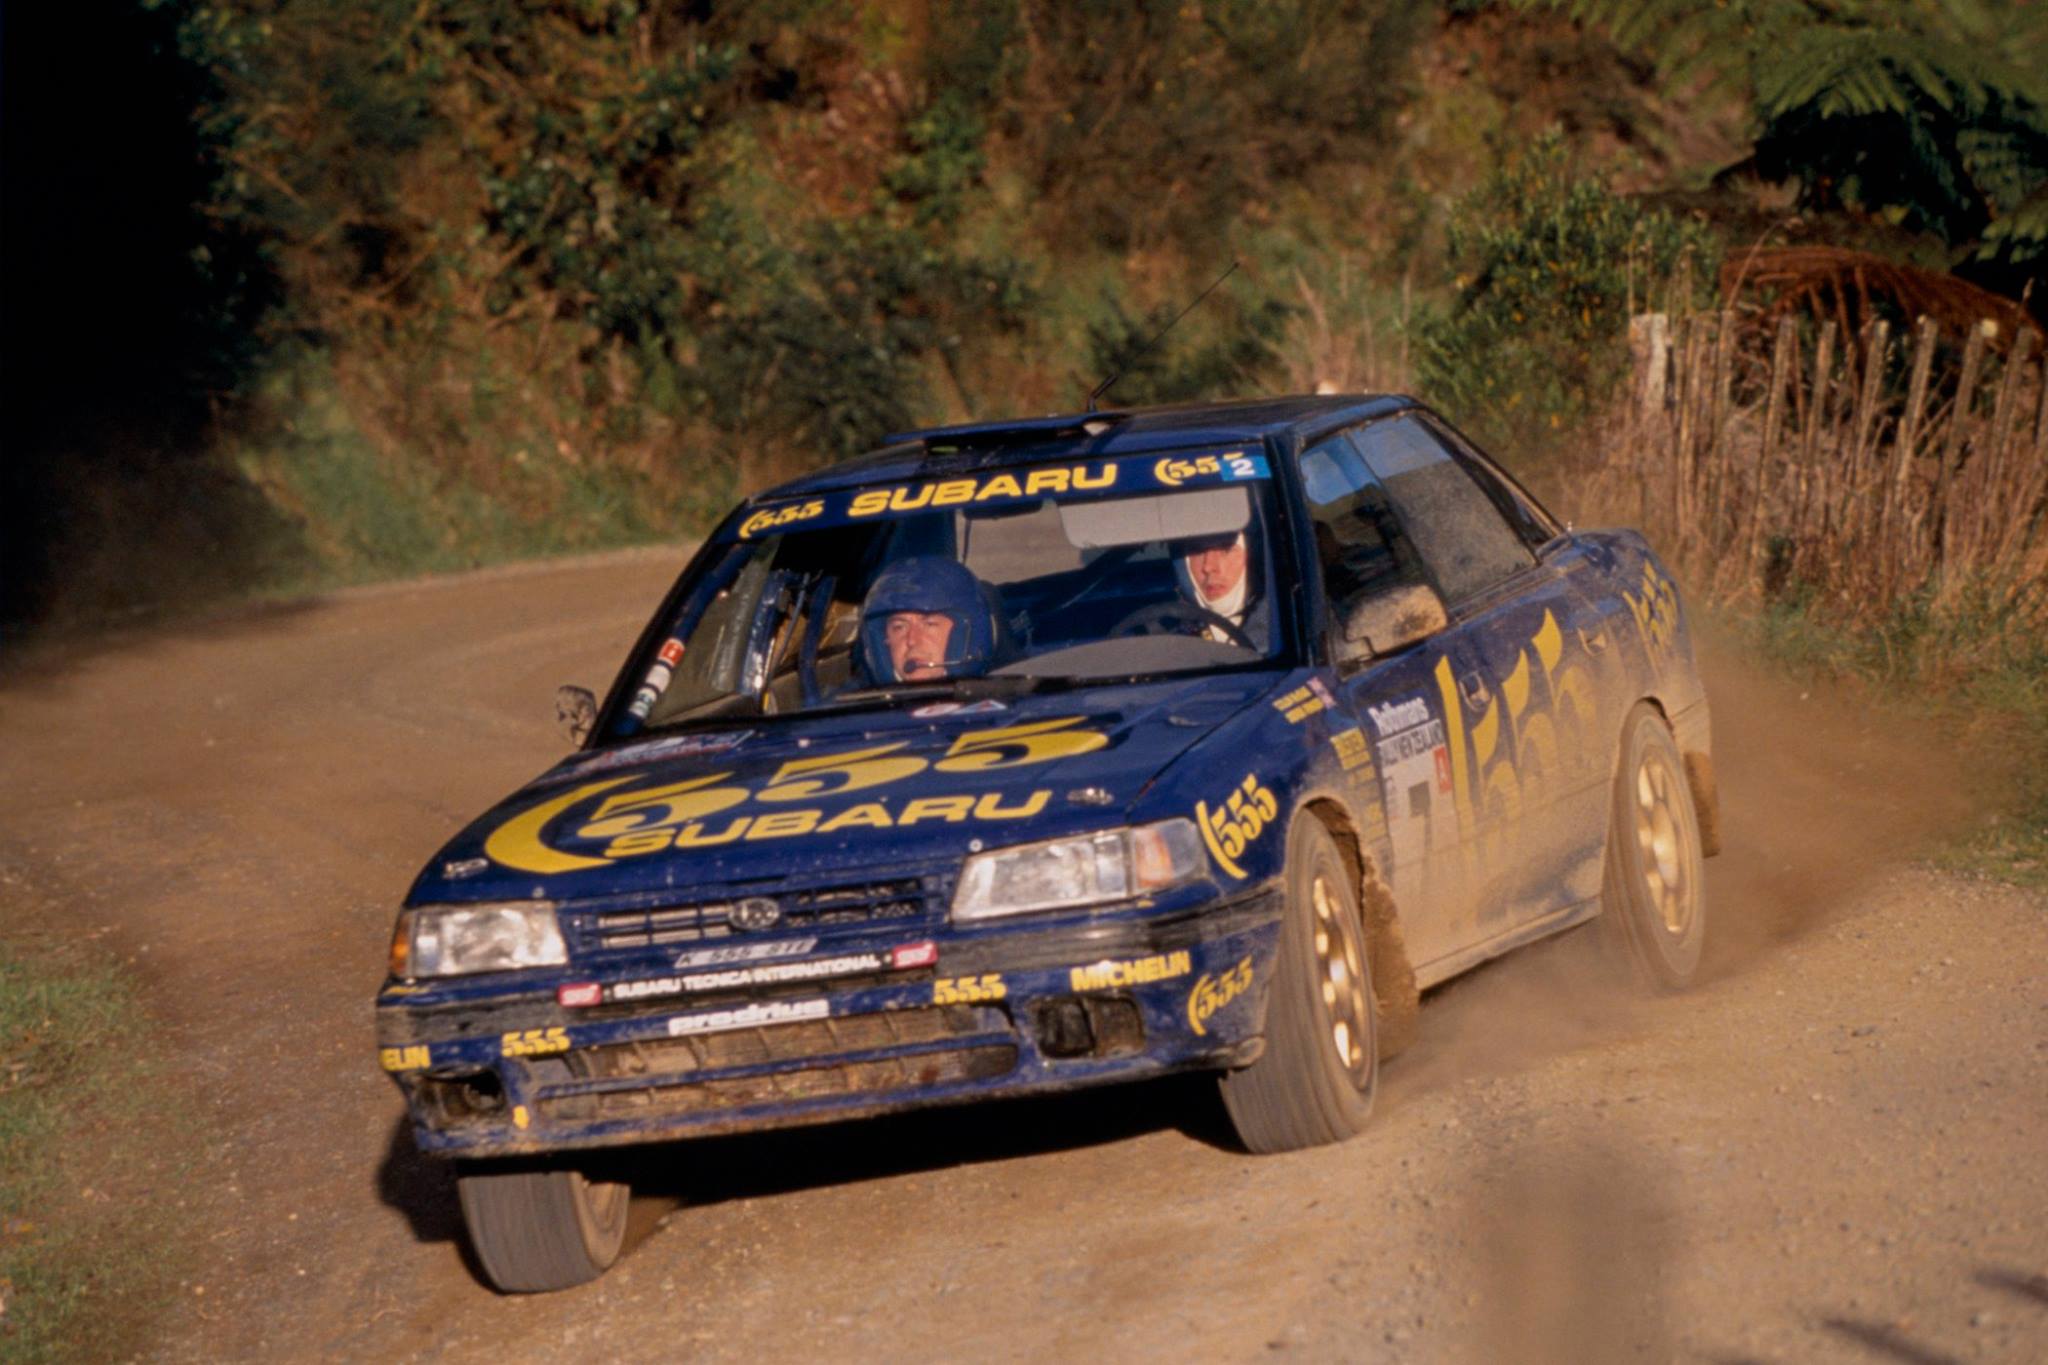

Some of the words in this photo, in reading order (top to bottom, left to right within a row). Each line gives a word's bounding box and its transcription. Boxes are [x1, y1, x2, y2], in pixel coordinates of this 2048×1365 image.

[1230, 458, 1256, 477] 2
[748, 500, 824, 532] 555
[847, 463, 1118, 519] SUBARU
[578, 715, 1110, 839] 555
[603, 789, 1054, 859] SUBARU
[1210, 772, 1278, 858] 555
[612, 977, 681, 1000] SUBARU
[933, 972, 1008, 1006] 555
[1069, 950, 1192, 993] MICHELIN
[1199, 955, 1253, 1021] 555
[501, 1026, 572, 1058] 555
